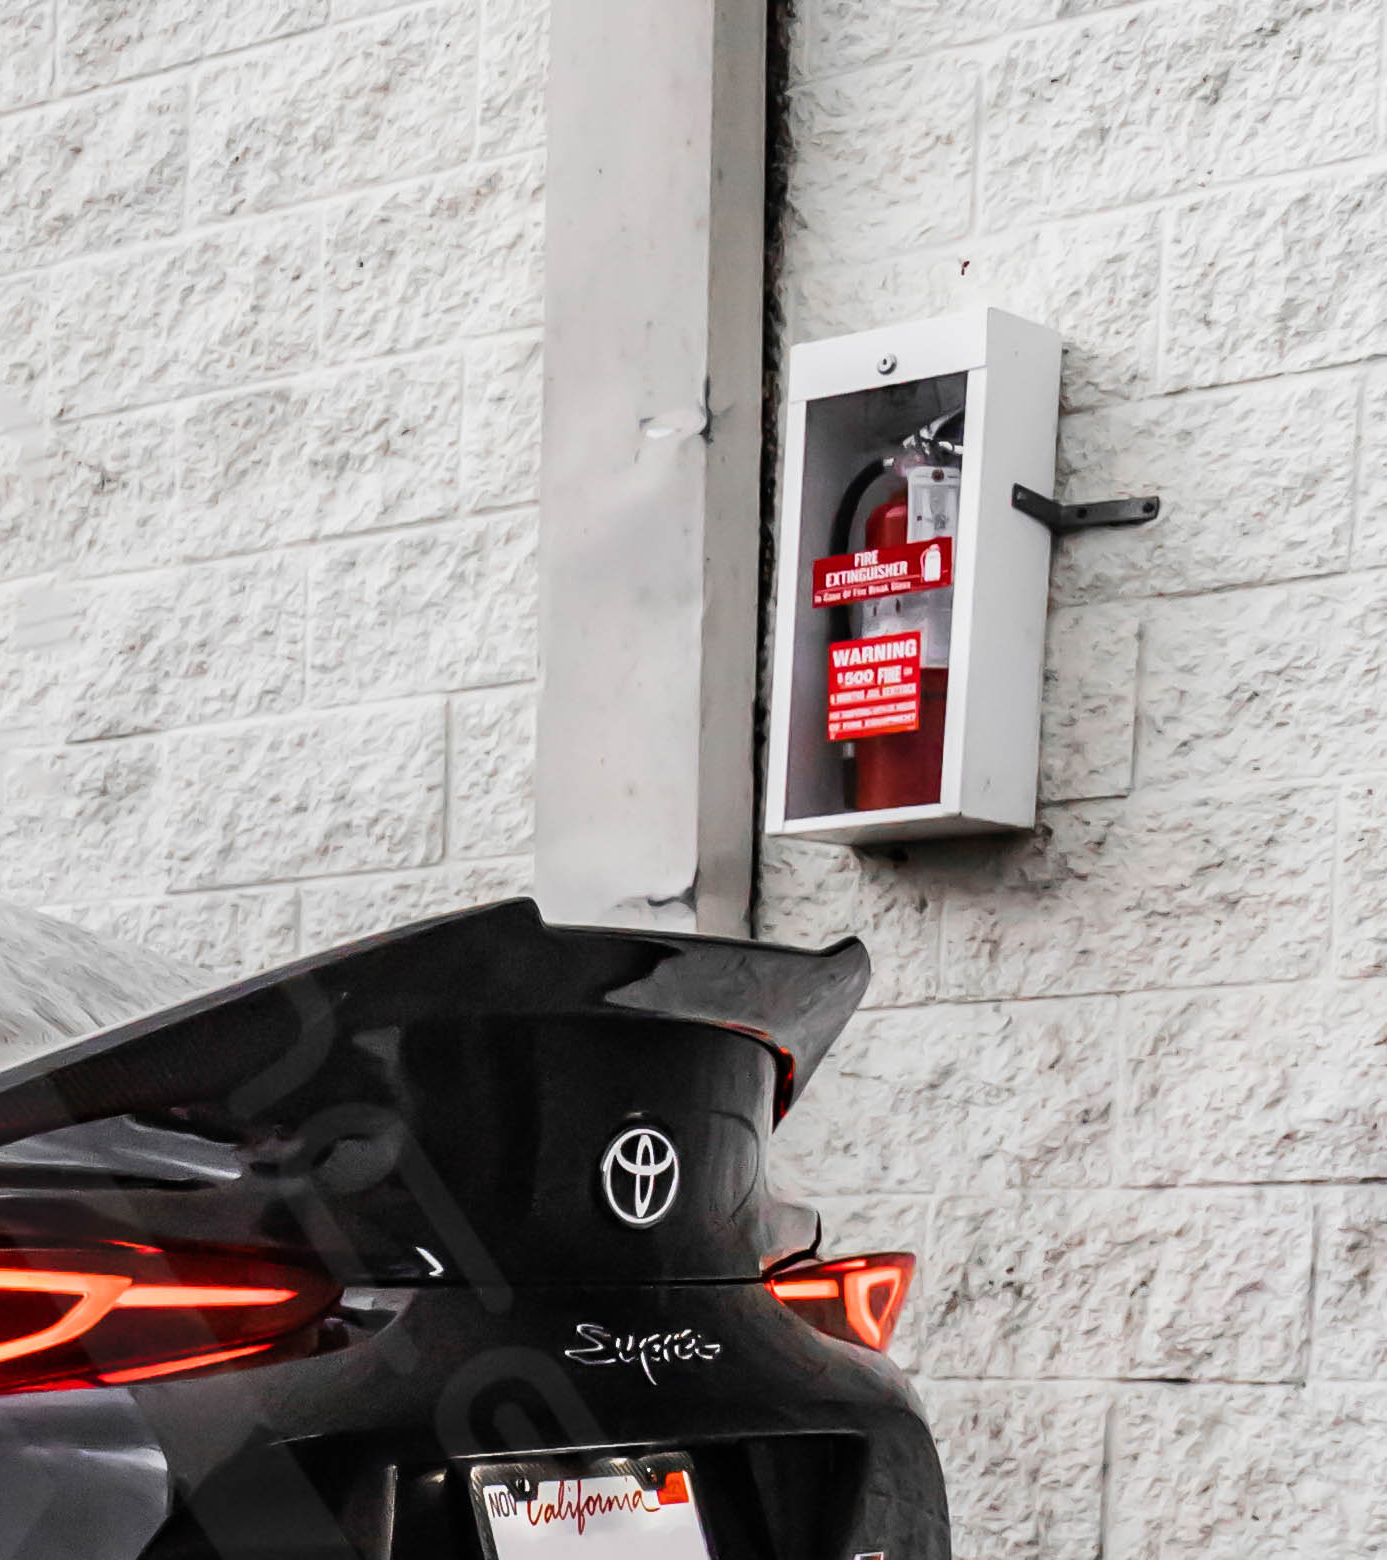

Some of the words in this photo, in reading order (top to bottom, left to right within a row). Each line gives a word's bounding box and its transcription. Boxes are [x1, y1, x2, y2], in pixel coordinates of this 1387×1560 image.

[855, 550, 879, 568] FIRE
[825, 560, 908, 588] EXTINGUISHER
[832, 639, 917, 668] WARNING
[565, 1324, 720, 1386] Supra
[527, 1479, 661, 1535] California
